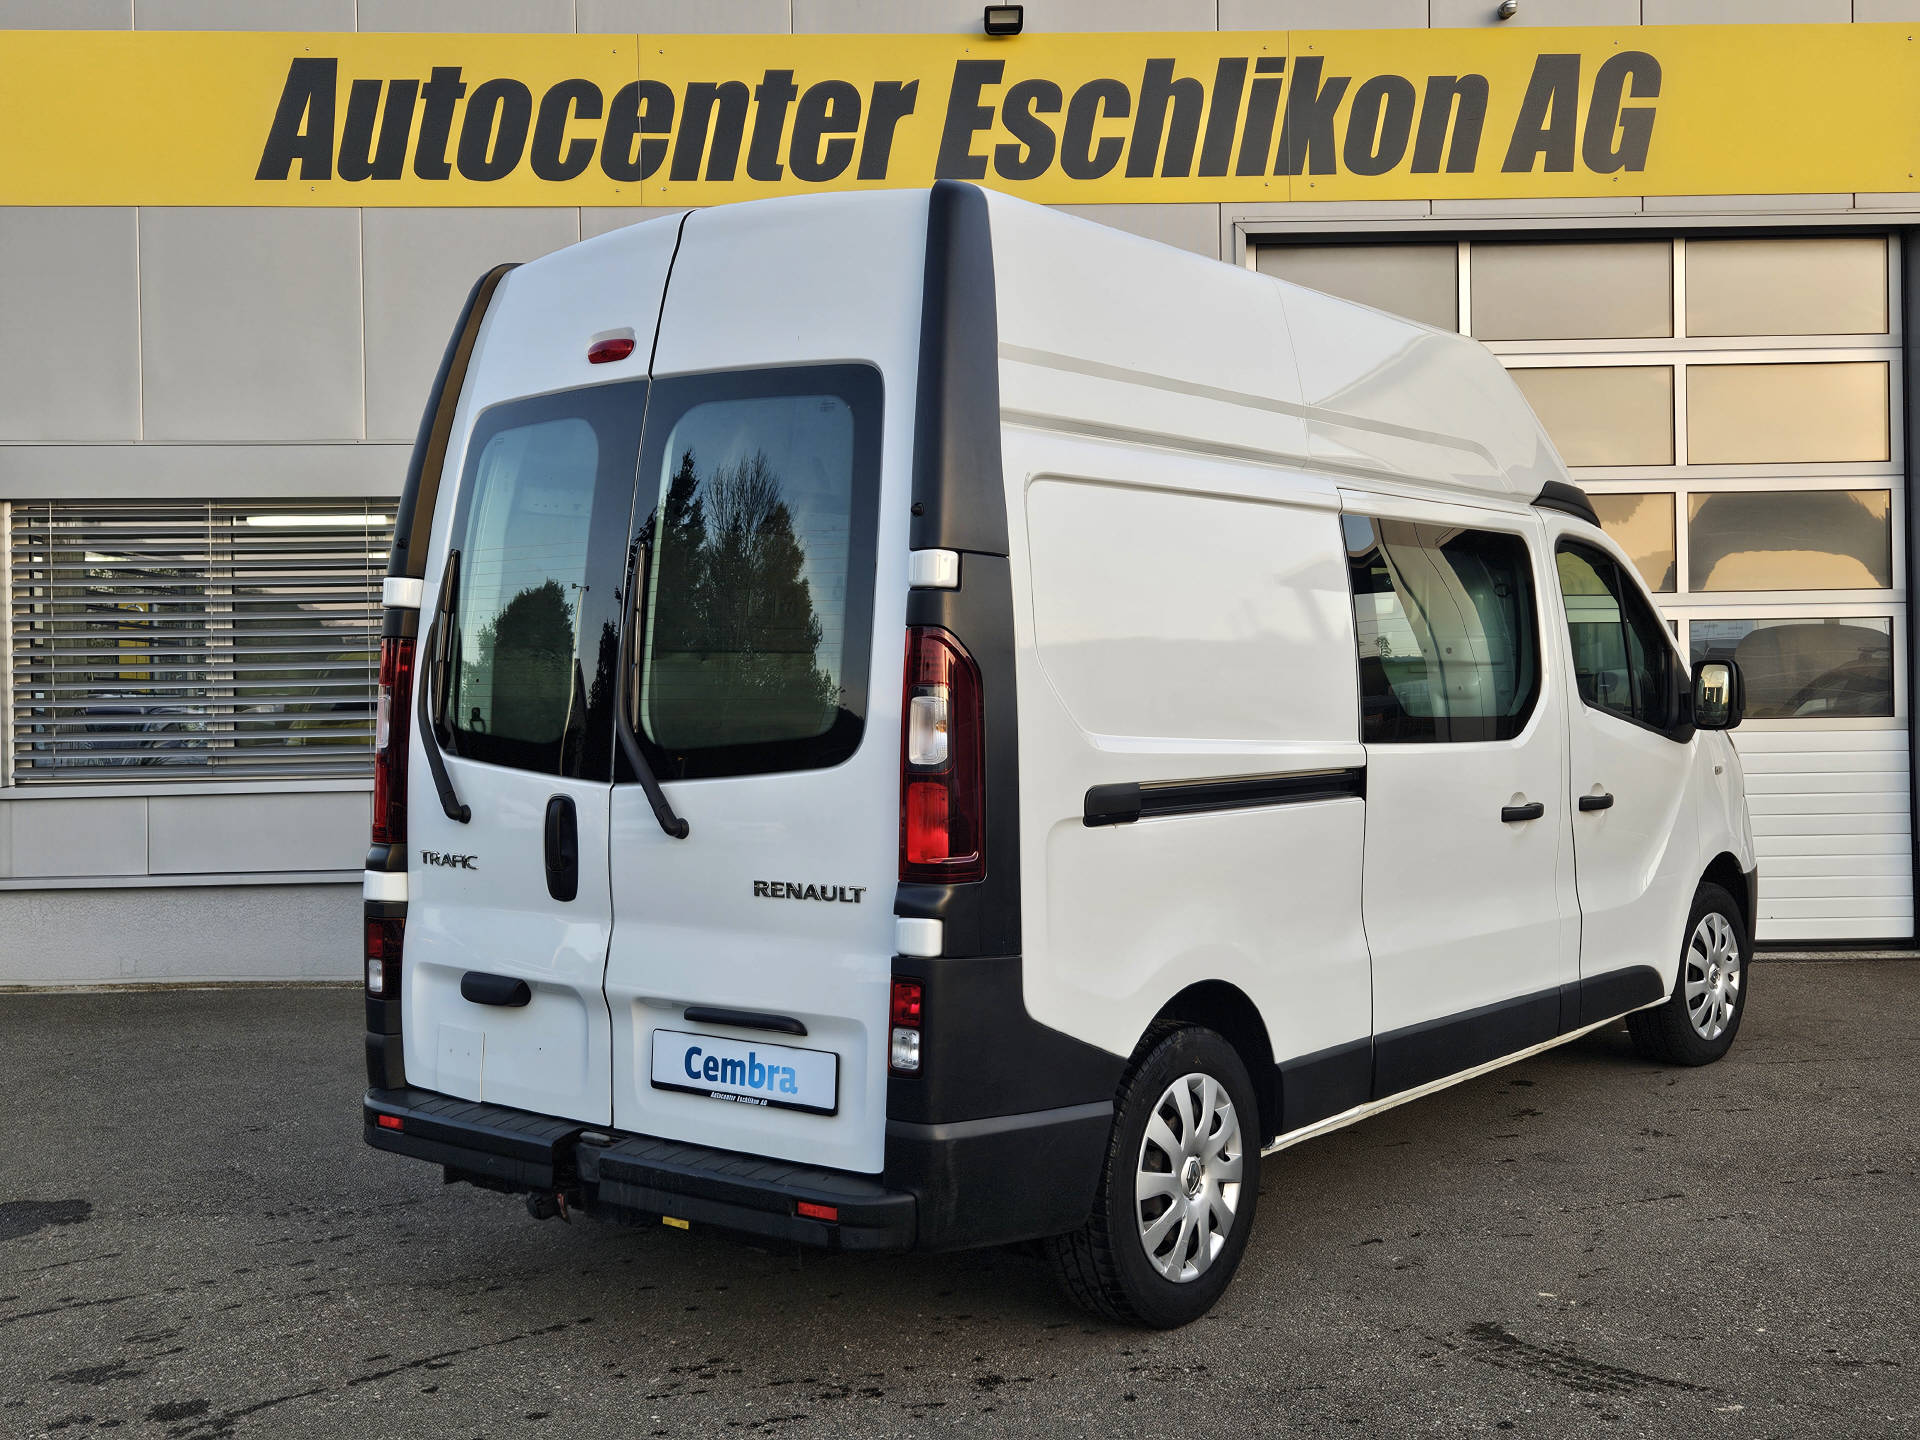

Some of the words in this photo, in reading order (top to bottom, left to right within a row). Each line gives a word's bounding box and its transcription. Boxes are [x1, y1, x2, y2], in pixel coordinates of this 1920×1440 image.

[254, 57, 920, 183] Autocenter
[934, 55, 1490, 181] Eschlikon
[1500, 50, 1663, 174] AG
[419, 849, 480, 870] TRAFIC
[752, 879, 867, 904] RENAULT
[684, 1046, 798, 1095] Cembra
[710, 1091, 736, 1101] Autocenter
